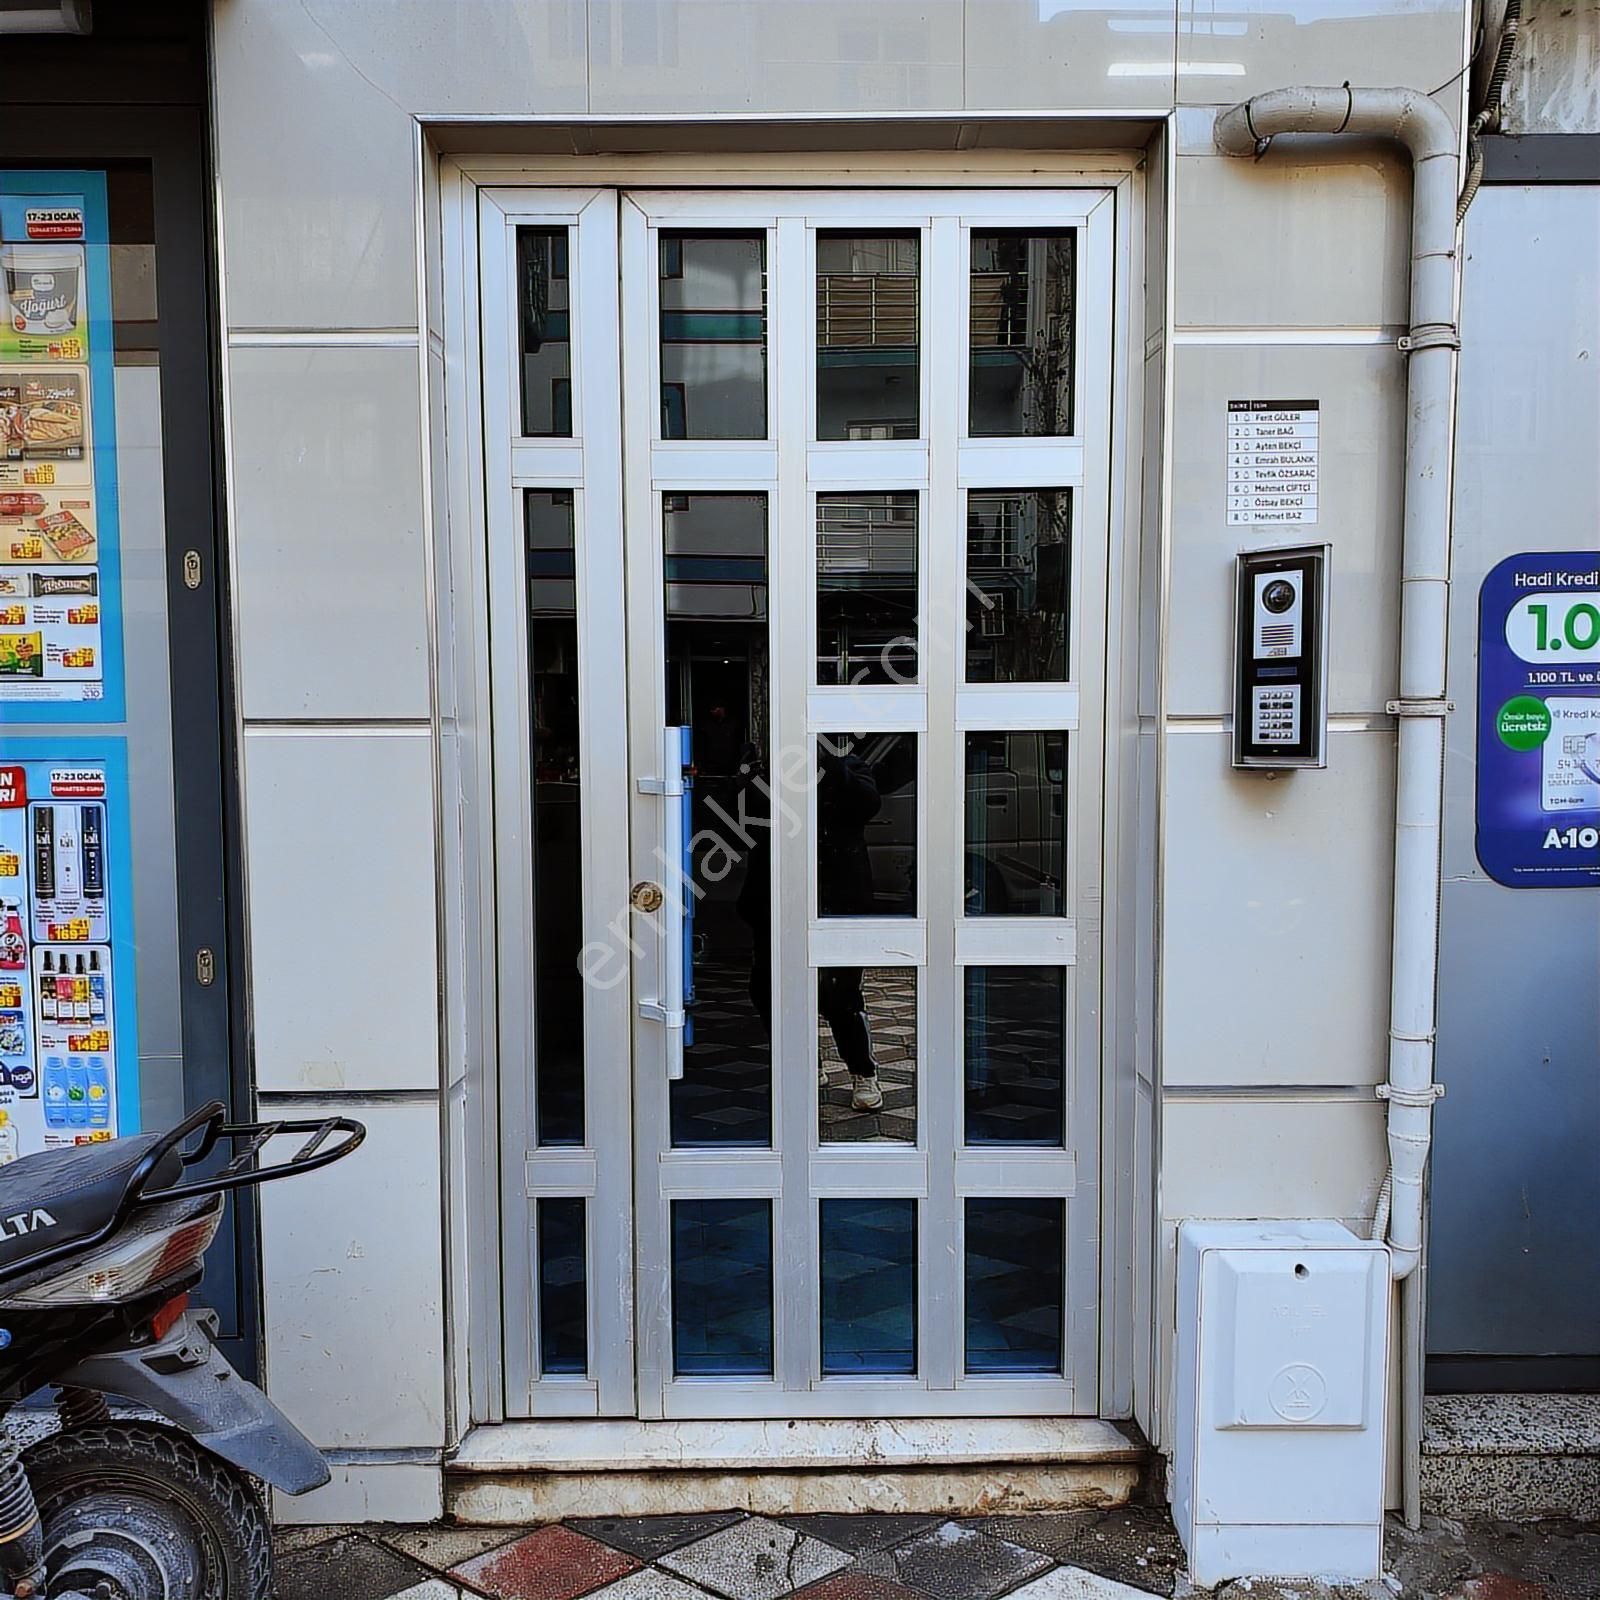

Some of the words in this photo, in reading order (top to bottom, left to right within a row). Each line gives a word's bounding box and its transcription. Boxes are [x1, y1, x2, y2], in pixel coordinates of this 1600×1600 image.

[53, 212, 80, 221] OCAK
[1234, 428, 1240, 436] 2
[1235, 442, 1240, 450] 3
[1235, 456, 1240, 464] 4
[1234, 471, 1240, 479] 5
[1234, 485, 1240, 493] 6
[1234, 499, 1239, 507] 7
[1233, 513, 1239, 521] 8
[1515, 572, 1552, 587] Hadi
[1556, 571, 1599, 587] Kredi
[1527, 603, 1600, 651] 1.0
[1528, 672, 1557, 683] 1.100
[1560, 672, 1576, 683] TL
[1578, 673, 1594, 682] ve
[1562, 710, 1588, 719] Kredi
[1501, 720, 1547, 732] ücretsiz
[55, 929, 79, 940] 169
[76, 1040, 98, 1051] 149
